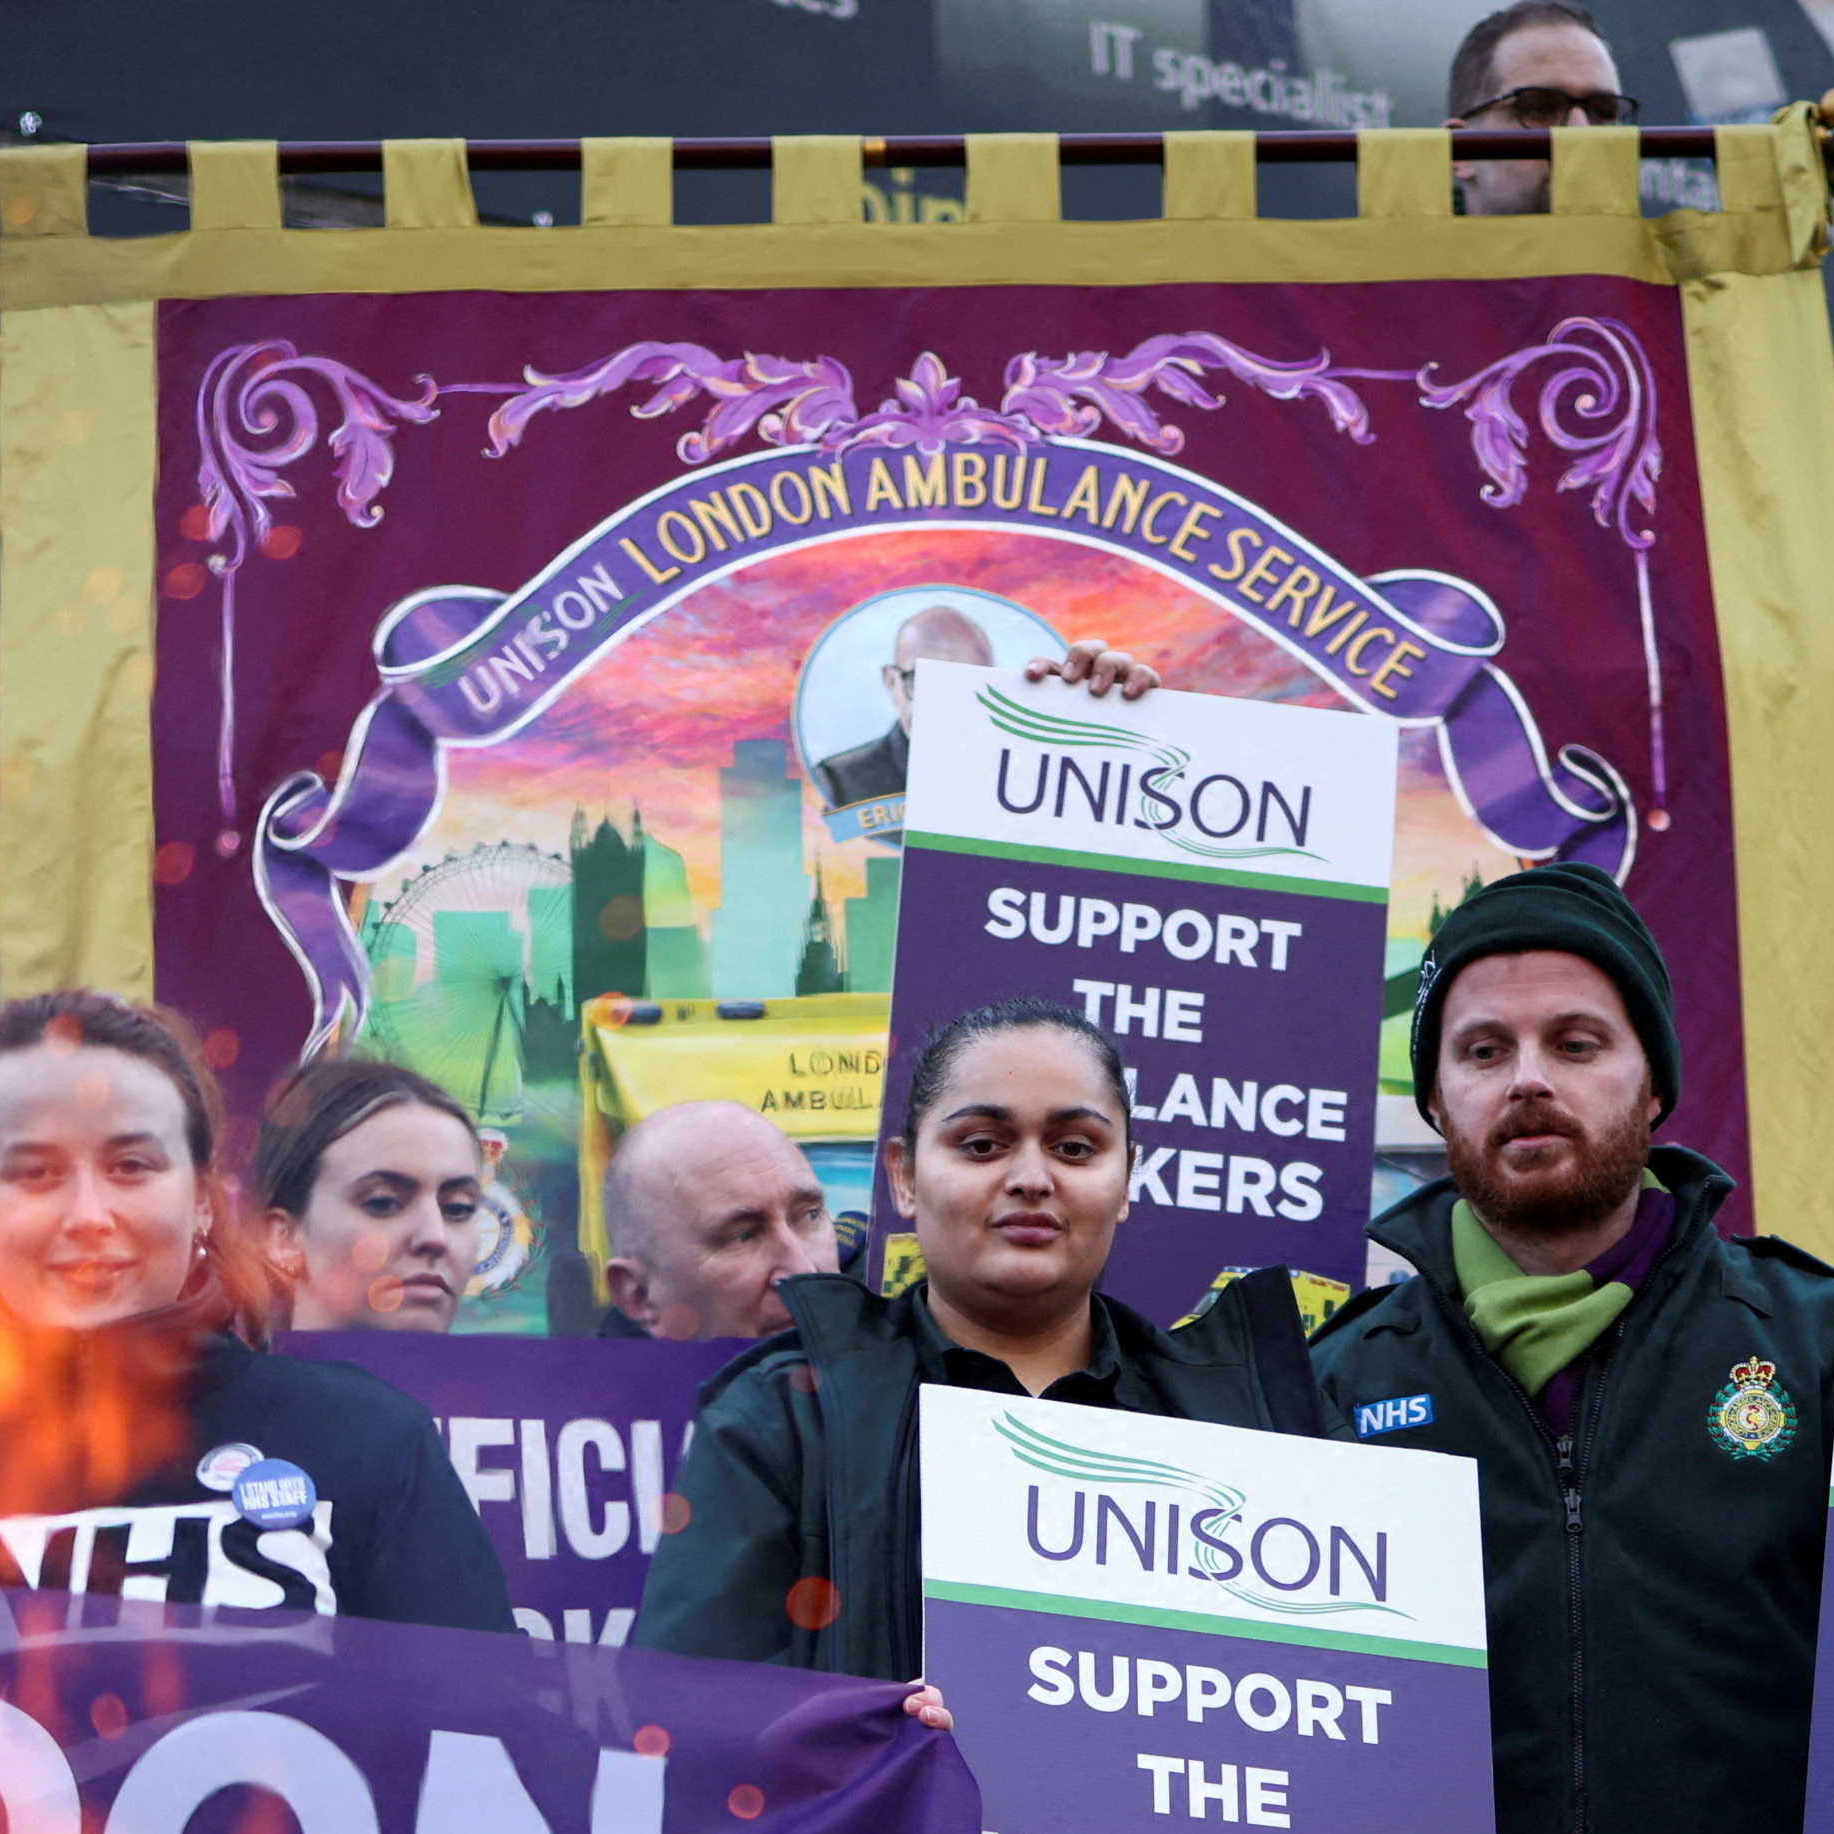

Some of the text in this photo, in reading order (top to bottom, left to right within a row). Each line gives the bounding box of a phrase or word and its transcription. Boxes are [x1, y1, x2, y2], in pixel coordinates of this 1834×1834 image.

[1090, 21, 1393, 129] IT specialist
[457, 452, 1427, 712] UNISON LONDON AMBULANCE SERVICE
[996, 749, 1313, 848] UNISON
[984, 887, 1302, 971] SUPPORT
[1073, 979, 1205, 1043] THE
[1125, 1067, 1349, 1143] LANCE
[1129, 1146, 1325, 1222] KERS
[1360, 1399, 1428, 1433] NHS
[1026, 1484, 1388, 1602] UNISON
[1027, 1646, 1393, 1747] SUPPORT
[1136, 1752, 1291, 1829] THE
